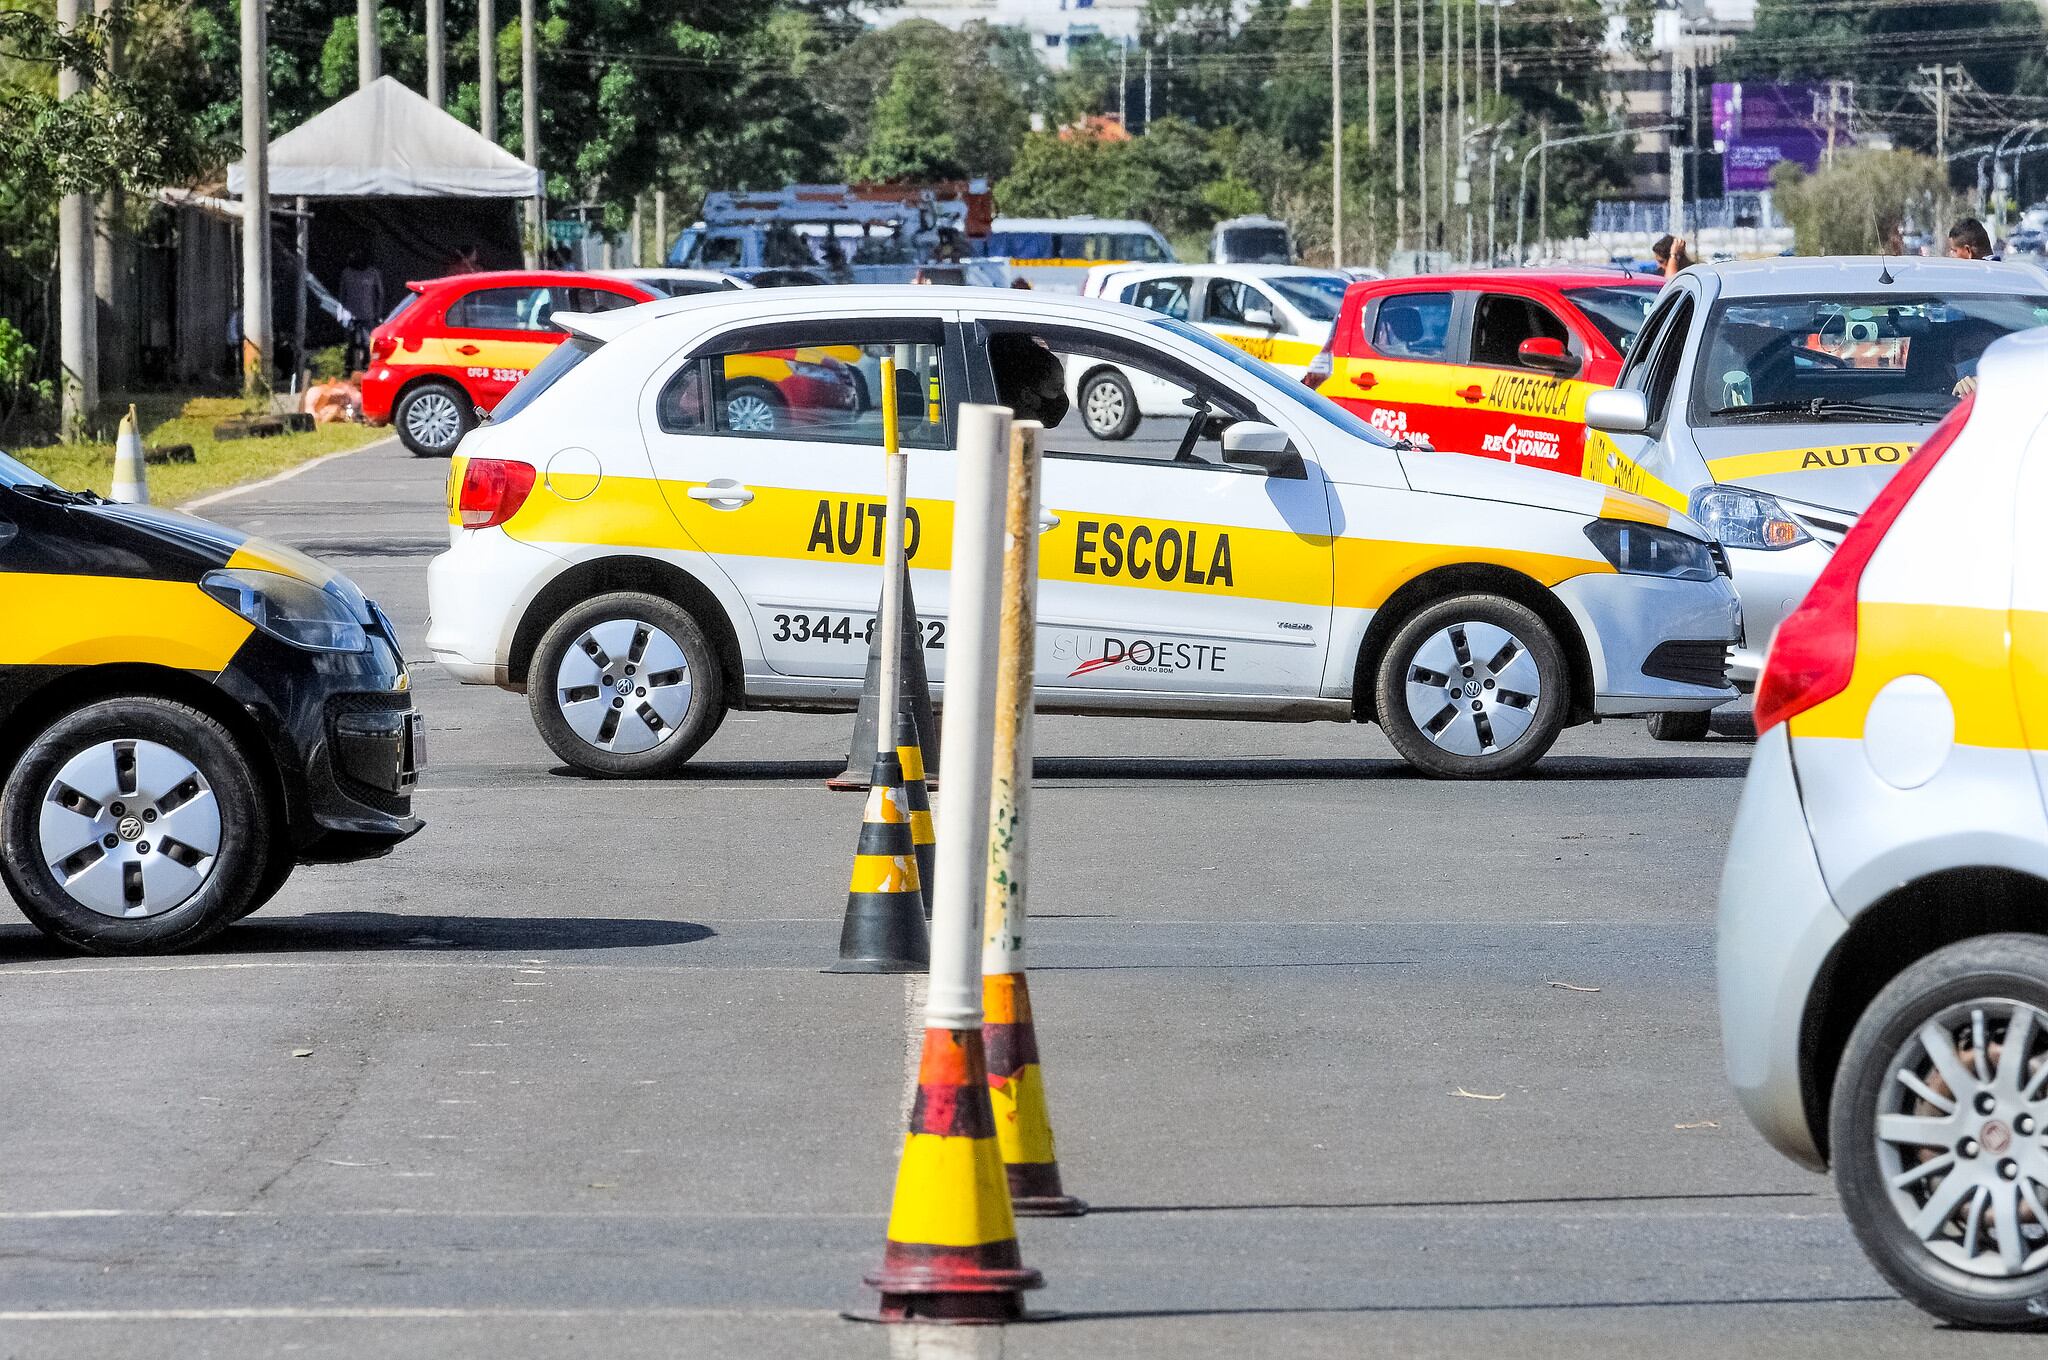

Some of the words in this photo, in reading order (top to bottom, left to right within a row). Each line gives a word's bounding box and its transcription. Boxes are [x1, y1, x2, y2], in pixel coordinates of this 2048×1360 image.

[1488, 375, 1572, 416] AUTOESCOLA
[1482, 423, 1560, 464] REGIONAL
[1517, 428, 1534, 438] AUTO
[1535, 431, 1560, 442] ESCOLA
[1802, 446, 1900, 469] AUTO
[806, 499, 921, 561] AUTO
[1074, 521, 1234, 587] ESCOLA
